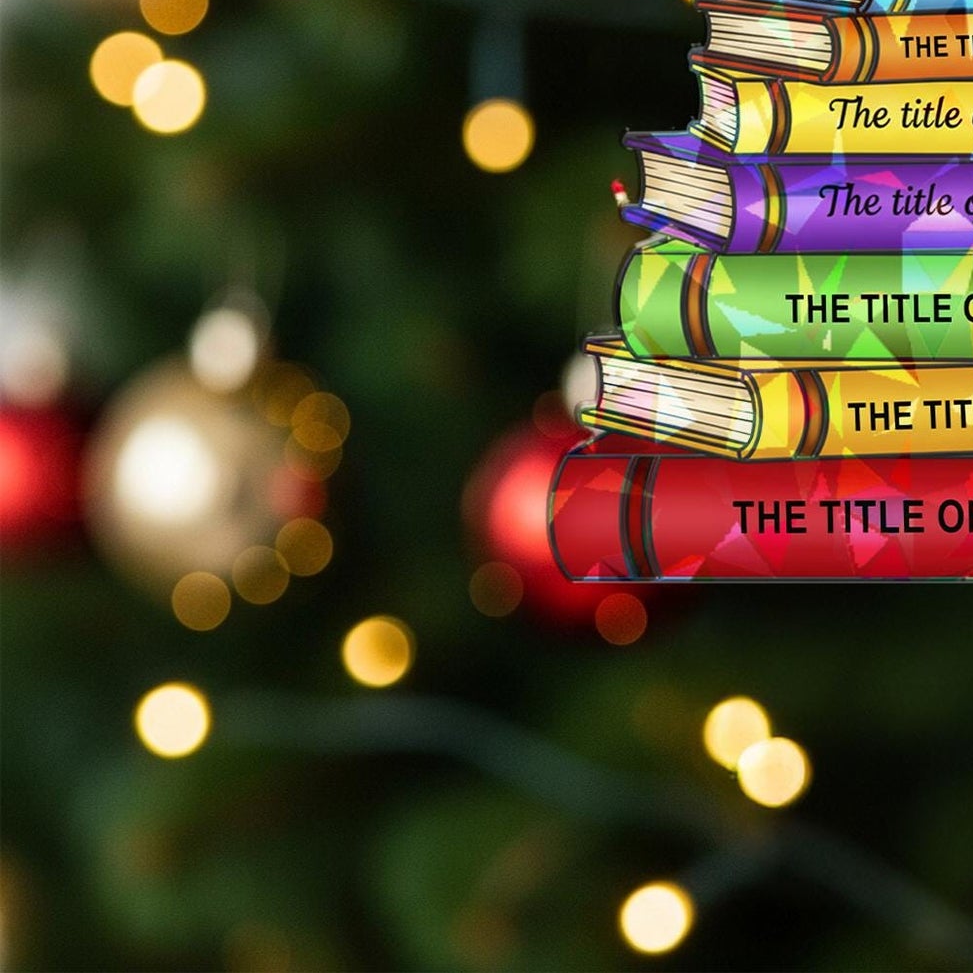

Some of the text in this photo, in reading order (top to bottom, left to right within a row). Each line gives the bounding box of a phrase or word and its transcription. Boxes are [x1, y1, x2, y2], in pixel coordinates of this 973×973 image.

[899, 35, 949, 58] THE
[829, 95, 891, 130] The
[901, 96, 963, 129] title
[819, 182, 882, 217] The
[892, 183, 954, 216] title
[785, 294, 850, 323] THE
[860, 293, 952, 324] TITLE
[847, 401, 913, 432] THE
[732, 500, 807, 534] THE
[819, 499, 925, 534] TITLE
